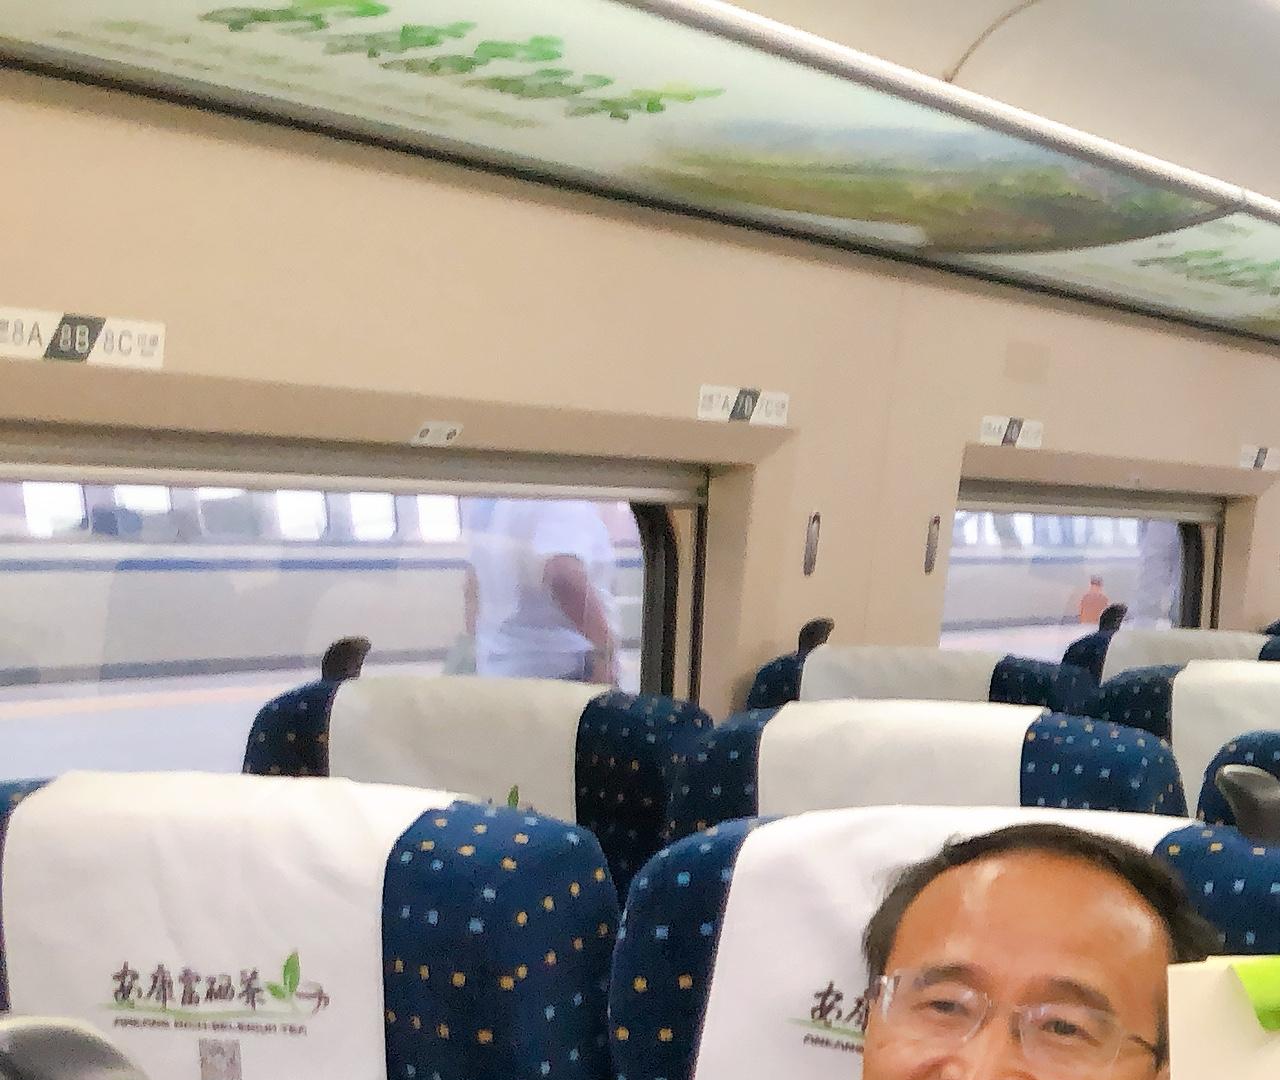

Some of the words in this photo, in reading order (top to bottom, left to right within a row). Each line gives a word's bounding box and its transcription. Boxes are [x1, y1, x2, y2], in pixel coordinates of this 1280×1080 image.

[110, 960, 266, 1012] 安康富硒茶
